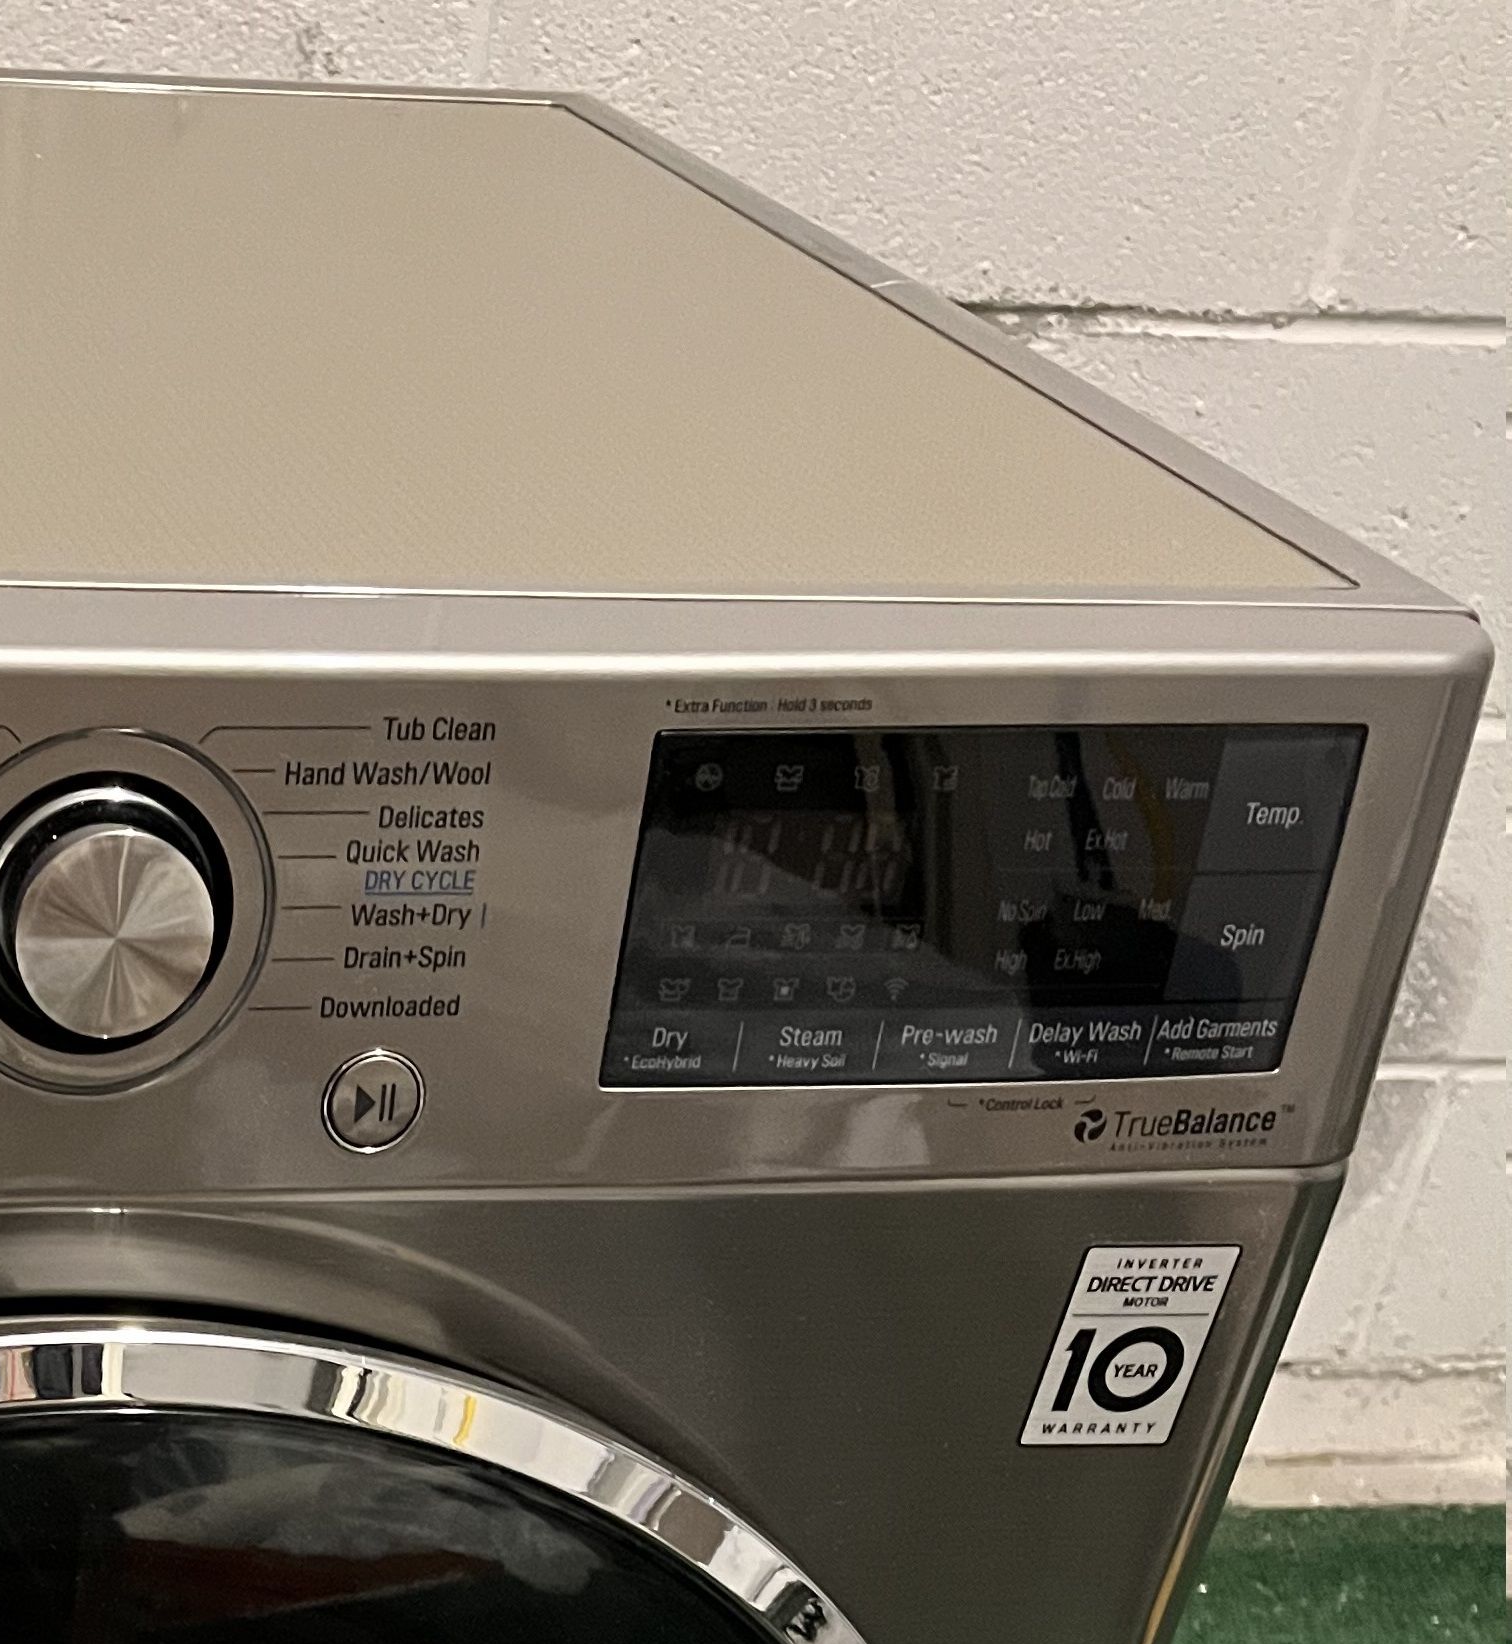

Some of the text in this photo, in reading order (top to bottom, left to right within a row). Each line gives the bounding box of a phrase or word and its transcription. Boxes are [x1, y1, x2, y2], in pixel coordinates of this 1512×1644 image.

[674, 698, 872, 713] Extra Function Hold 3 seconds
[384, 716, 496, 742] Tub Clean
[284, 761, 492, 786] Hand Wash/Wool
[1102, 776, 1137, 800] Cold
[1165, 776, 1210, 800] Warm
[378, 806, 484, 829] Delicates
[1024, 829, 1052, 851] Hot
[346, 840, 480, 864] Quick Wash
[365, 870, 476, 891] DRY CYCLE
[351, 904, 471, 931] Wash+Dry
[1073, 900, 1107, 922] Low
[1220, 923, 1265, 950] Spin
[344, 946, 466, 970] Drain+Spin
[994, 949, 1028, 976] High
[320, 996, 460, 1019] Downloaded
[652, 1027, 688, 1051] Dry
[780, 1026, 843, 1047] Steam
[901, 1024, 998, 1046] Pre-wash
[1029, 1021, 1142, 1047] Delay Wash
[1156, 1018, 1278, 1040] Add Garments
[631, 1055, 701, 1071] EcoHybrid
[776, 1053, 846, 1071] Heavy Soil
[928, 1052, 968, 1069] Signal
[1063, 1049, 1098, 1064] Wi-Fi
[1171, 1045, 1253, 1061] Remote Start
[986, 1097, 1064, 1111] Control Lock
[1116, 1257, 1204, 1270] INVERTER
[1087, 1274, 1219, 1293] DIRECT DRIVE
[1122, 1296, 1169, 1308] MOTOR
[1051, 1325, 1185, 1413] 10
[1113, 1363, 1159, 1379] YEAR
[1041, 1422, 1157, 1435] WARRANTY
